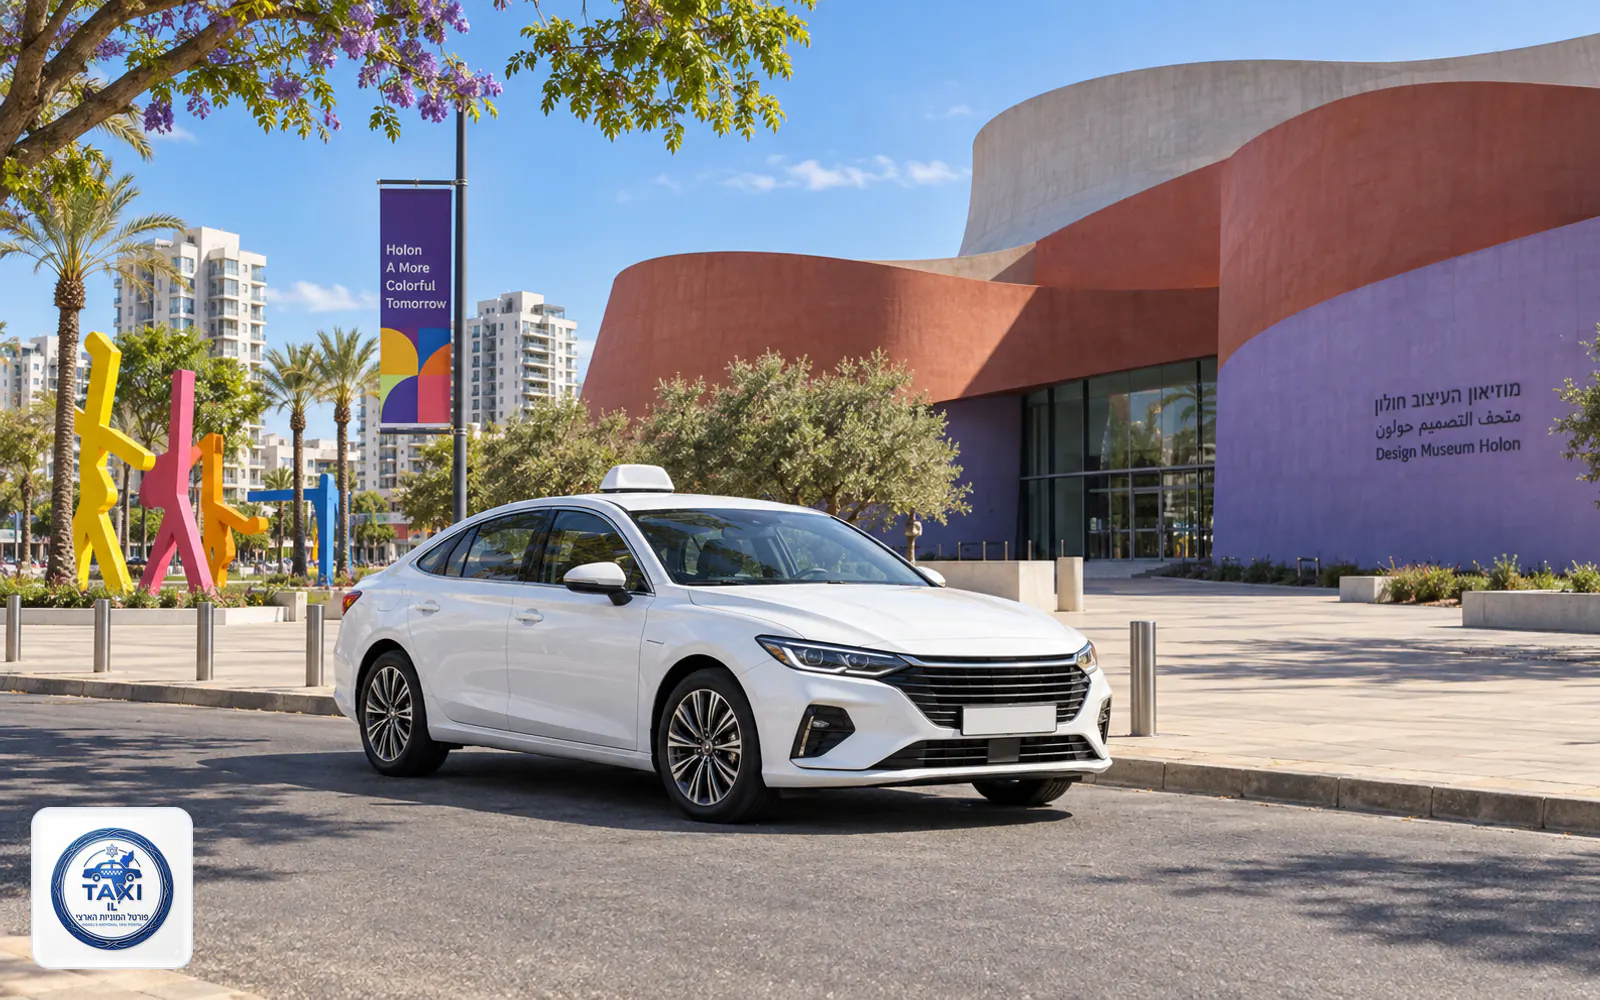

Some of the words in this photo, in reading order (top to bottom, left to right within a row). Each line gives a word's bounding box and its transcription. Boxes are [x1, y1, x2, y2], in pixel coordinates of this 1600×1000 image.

[386, 244, 422, 256] Holon
[386, 262, 396, 273] A
[399, 262, 430, 273] More
[386, 279, 436, 291] Colorful
[386, 297, 447, 309] Tomorrow
[1411, 389, 1462, 408] העיצוב
[1468, 382, 1521, 405] מוזיאון
[1375, 394, 1406, 416] חולון
[1418, 412, 1473, 436] التصميم
[1478, 410, 1521, 425] متحف
[1375, 420, 1414, 439] حولون
[1376, 446, 1417, 463] Design
[1421, 443, 1475, 458] Museum
[1479, 437, 1521, 453] Holon
